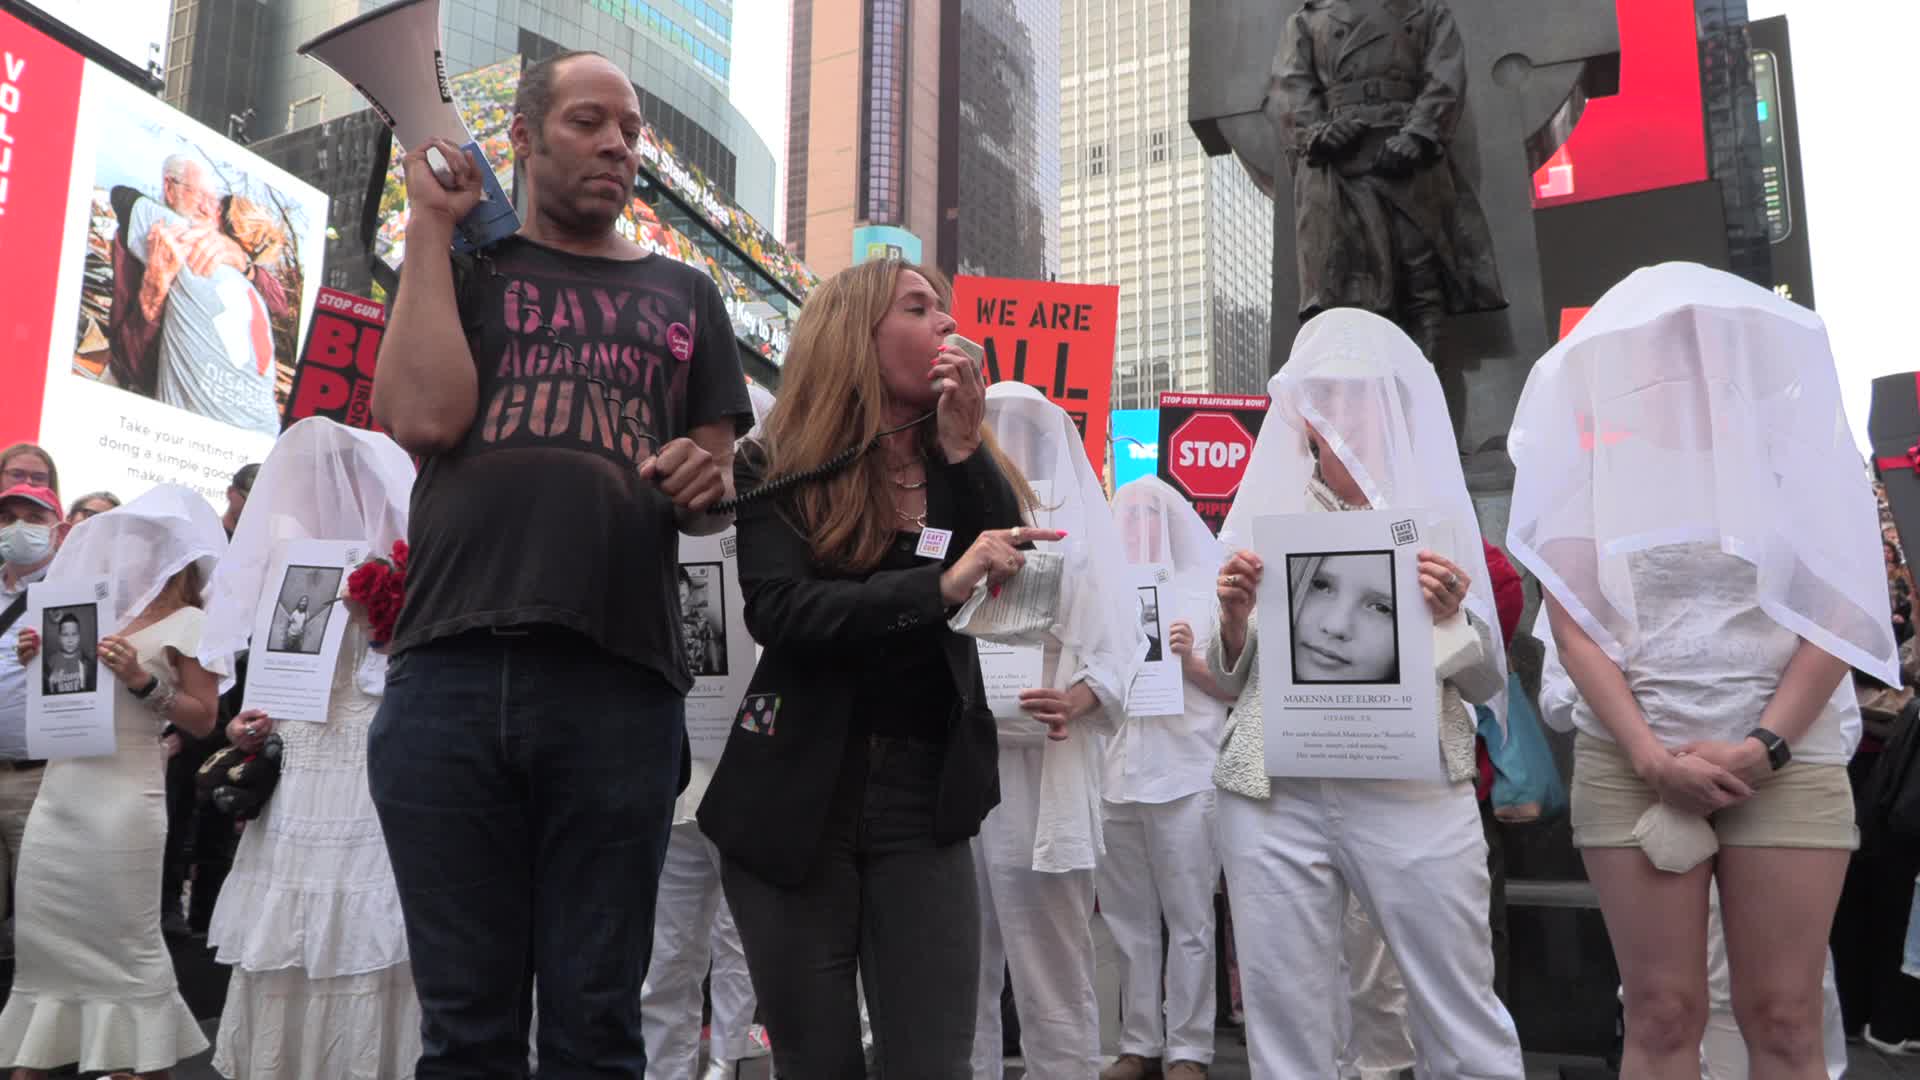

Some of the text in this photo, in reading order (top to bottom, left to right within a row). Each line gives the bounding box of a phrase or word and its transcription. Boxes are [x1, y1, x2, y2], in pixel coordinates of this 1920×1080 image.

[319, 293, 381, 319] STOP GUN
[503, 279, 668, 347] GAYS
[977, 297, 1093, 331] WE ARE
[497, 338, 662, 393] AGAINST
[1161, 395, 1181, 404] STOP
[1182, 396, 1198, 405] GUN
[1199, 397, 1244, 406] TRAFFICKING
[119, 415, 249, 464] Take your instinct of
[481, 380, 657, 469] GUNS
[98, 435, 141, 458] doing
[156, 451, 200, 472] simple
[1179, 441, 1246, 468] STOP
[126, 466, 165, 484] make
[1283, 695, 1333, 704] MAKENNA
[1335, 695, 1354, 704] LEE
[1356, 695, 1392, 704] ELROD
[1401, 695, 1413, 704] 10
